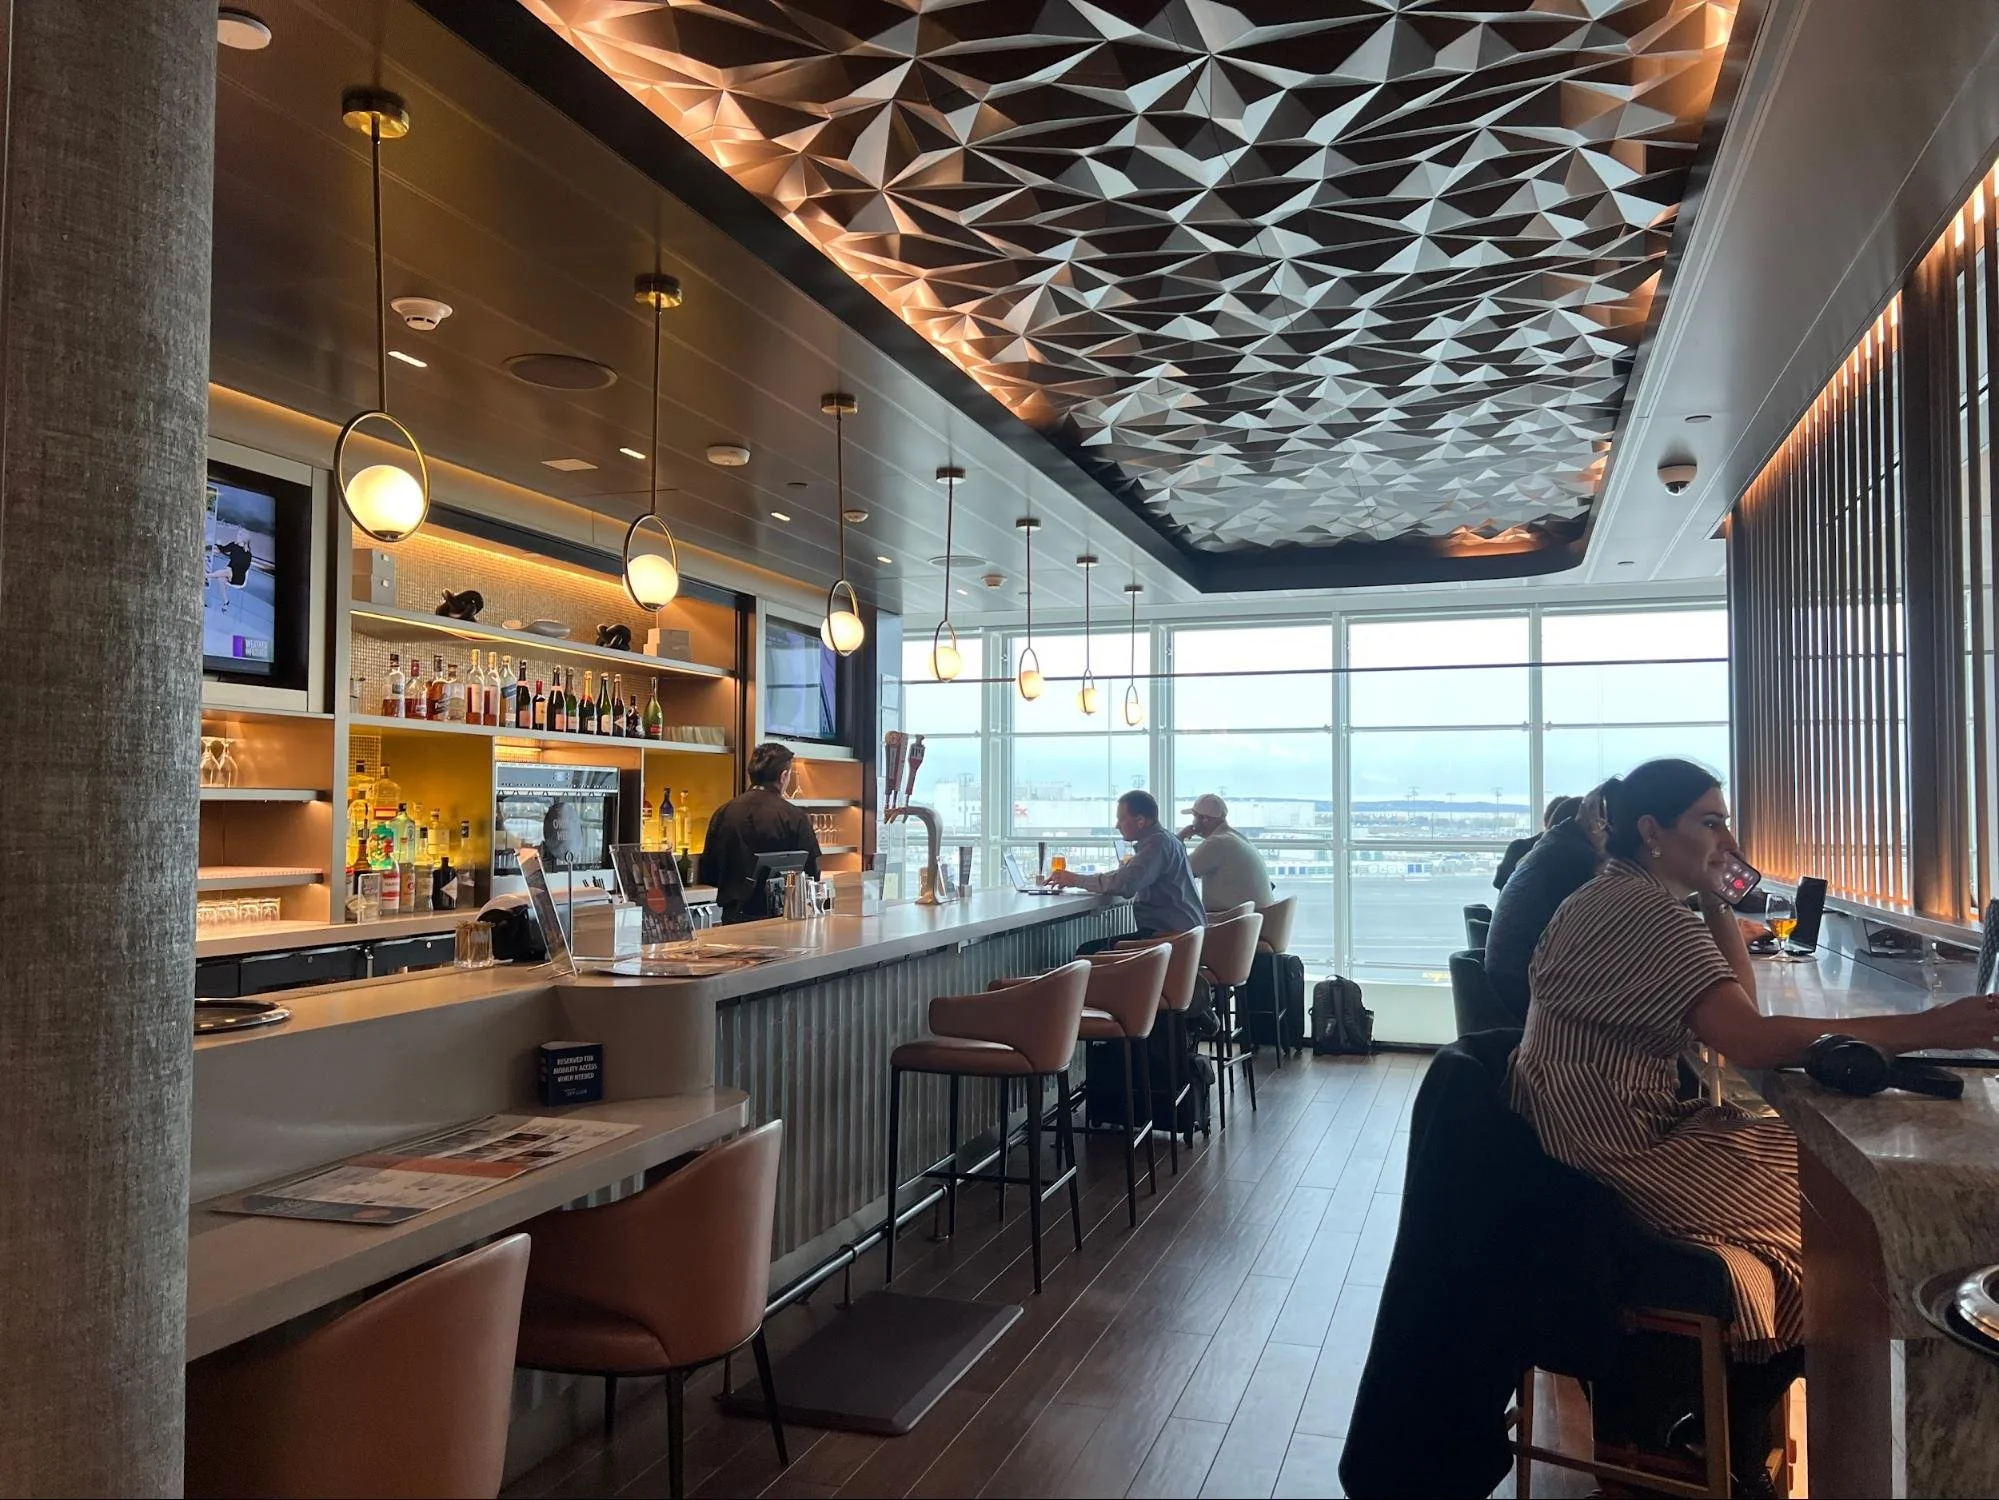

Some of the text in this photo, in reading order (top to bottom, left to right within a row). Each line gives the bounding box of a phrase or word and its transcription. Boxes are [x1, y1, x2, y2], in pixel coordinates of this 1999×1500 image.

[557, 1056, 584, 1066] RESERVED
[553, 1063, 598, 1075] MOBILITY ACCESS
